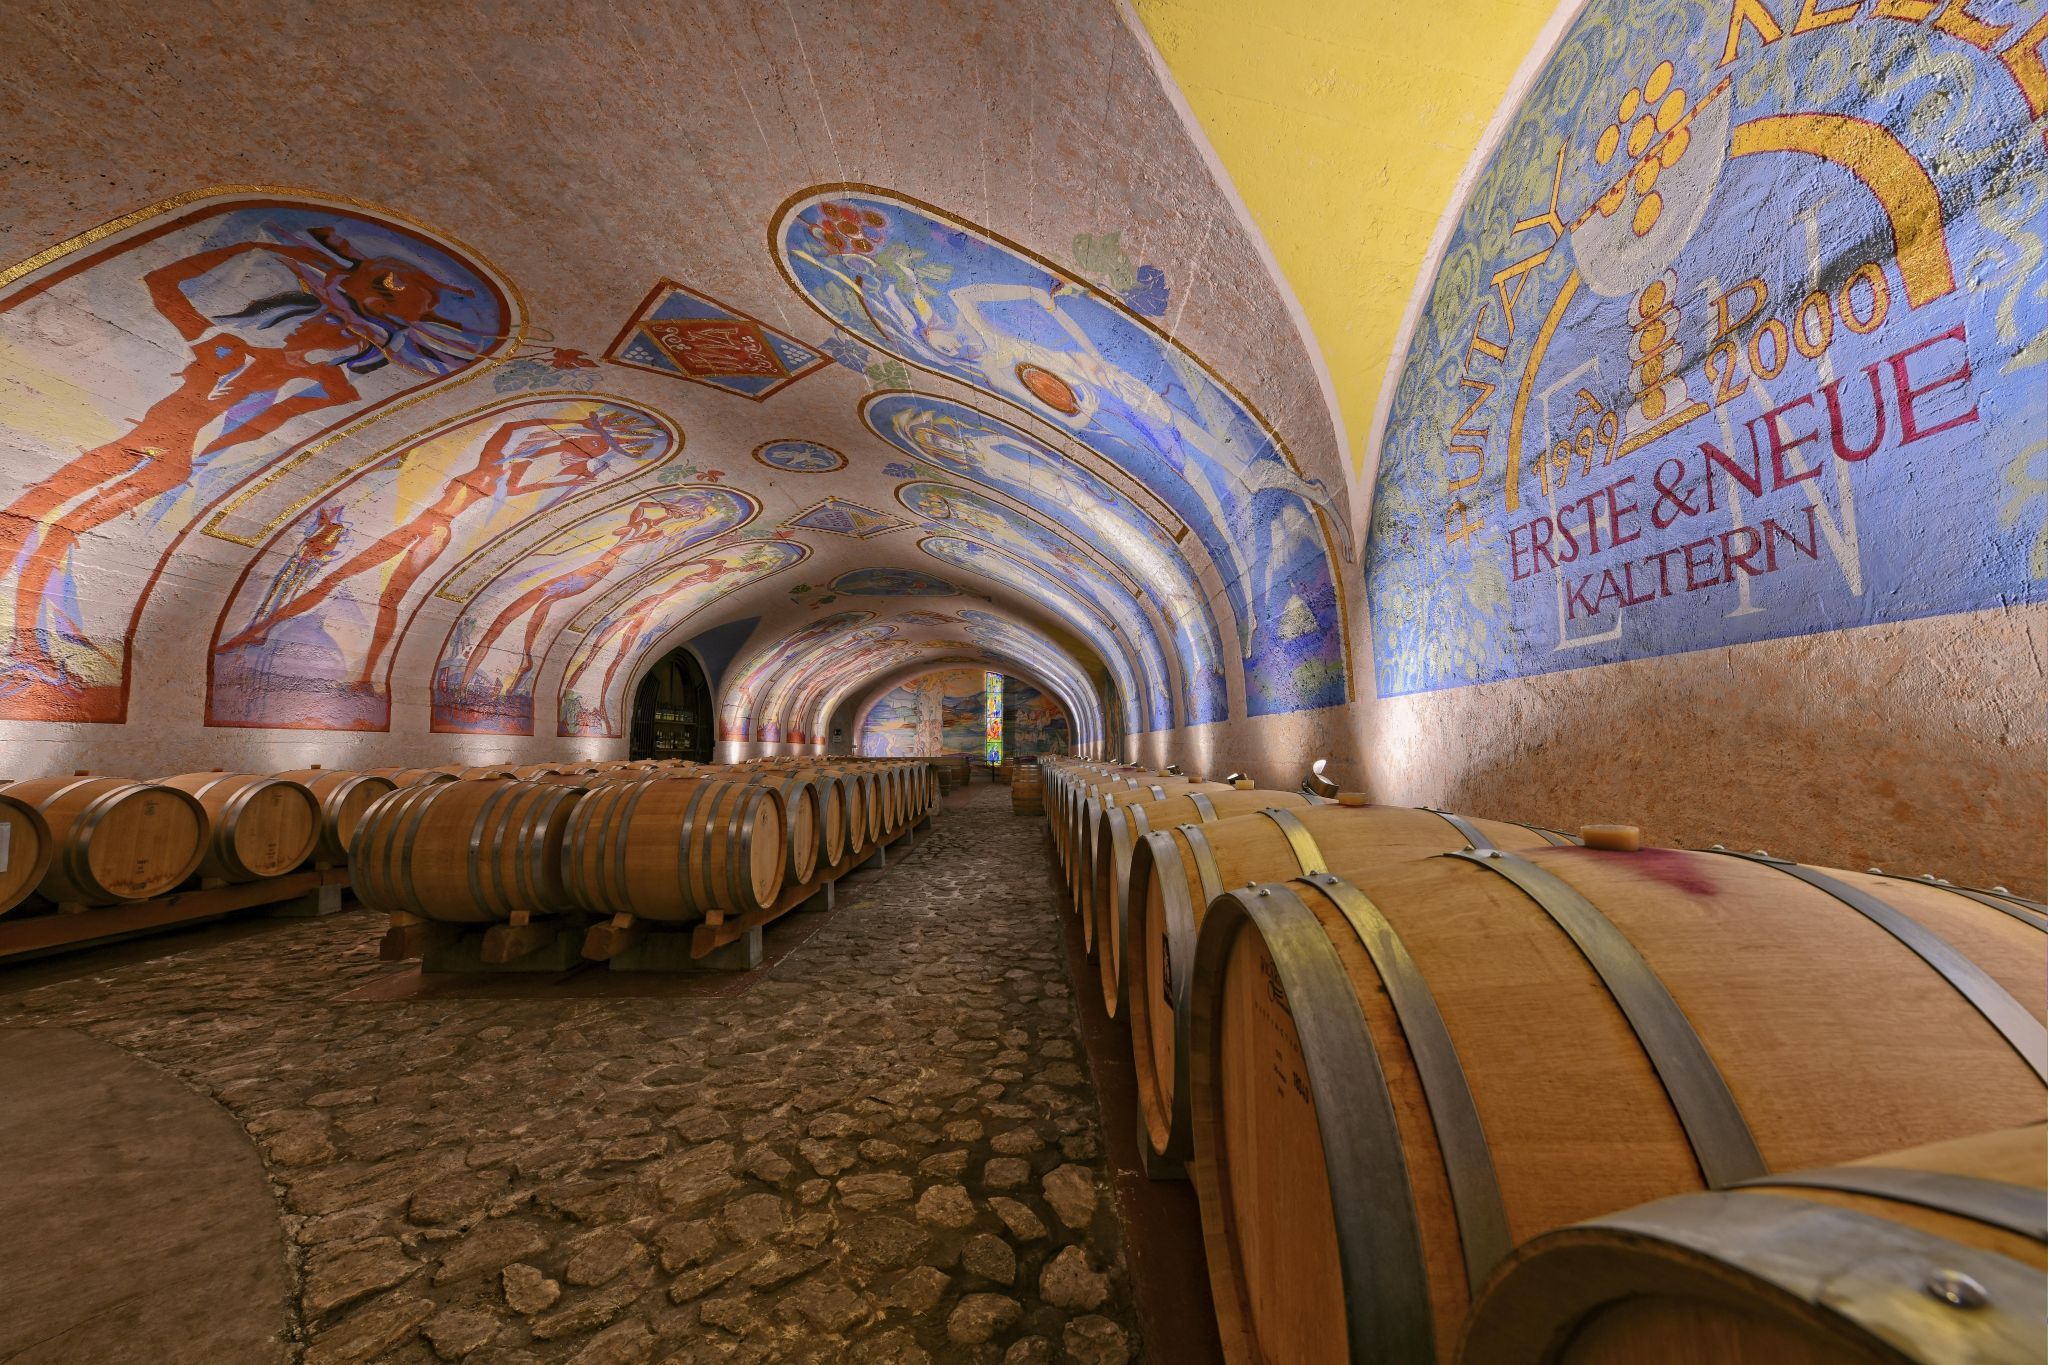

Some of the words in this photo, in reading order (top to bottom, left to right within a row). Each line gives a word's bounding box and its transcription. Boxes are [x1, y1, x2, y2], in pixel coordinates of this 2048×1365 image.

[1446, 140, 1569, 550] PUNTAY
[1508, 474, 1643, 583] ERSTE
[1649, 456, 1701, 531] &
[1696, 321, 1980, 514] NEUE
[1531, 410, 1620, 498] 1999
[1705, 261, 1891, 408] 2000
[1565, 503, 1821, 621] KALTERN
